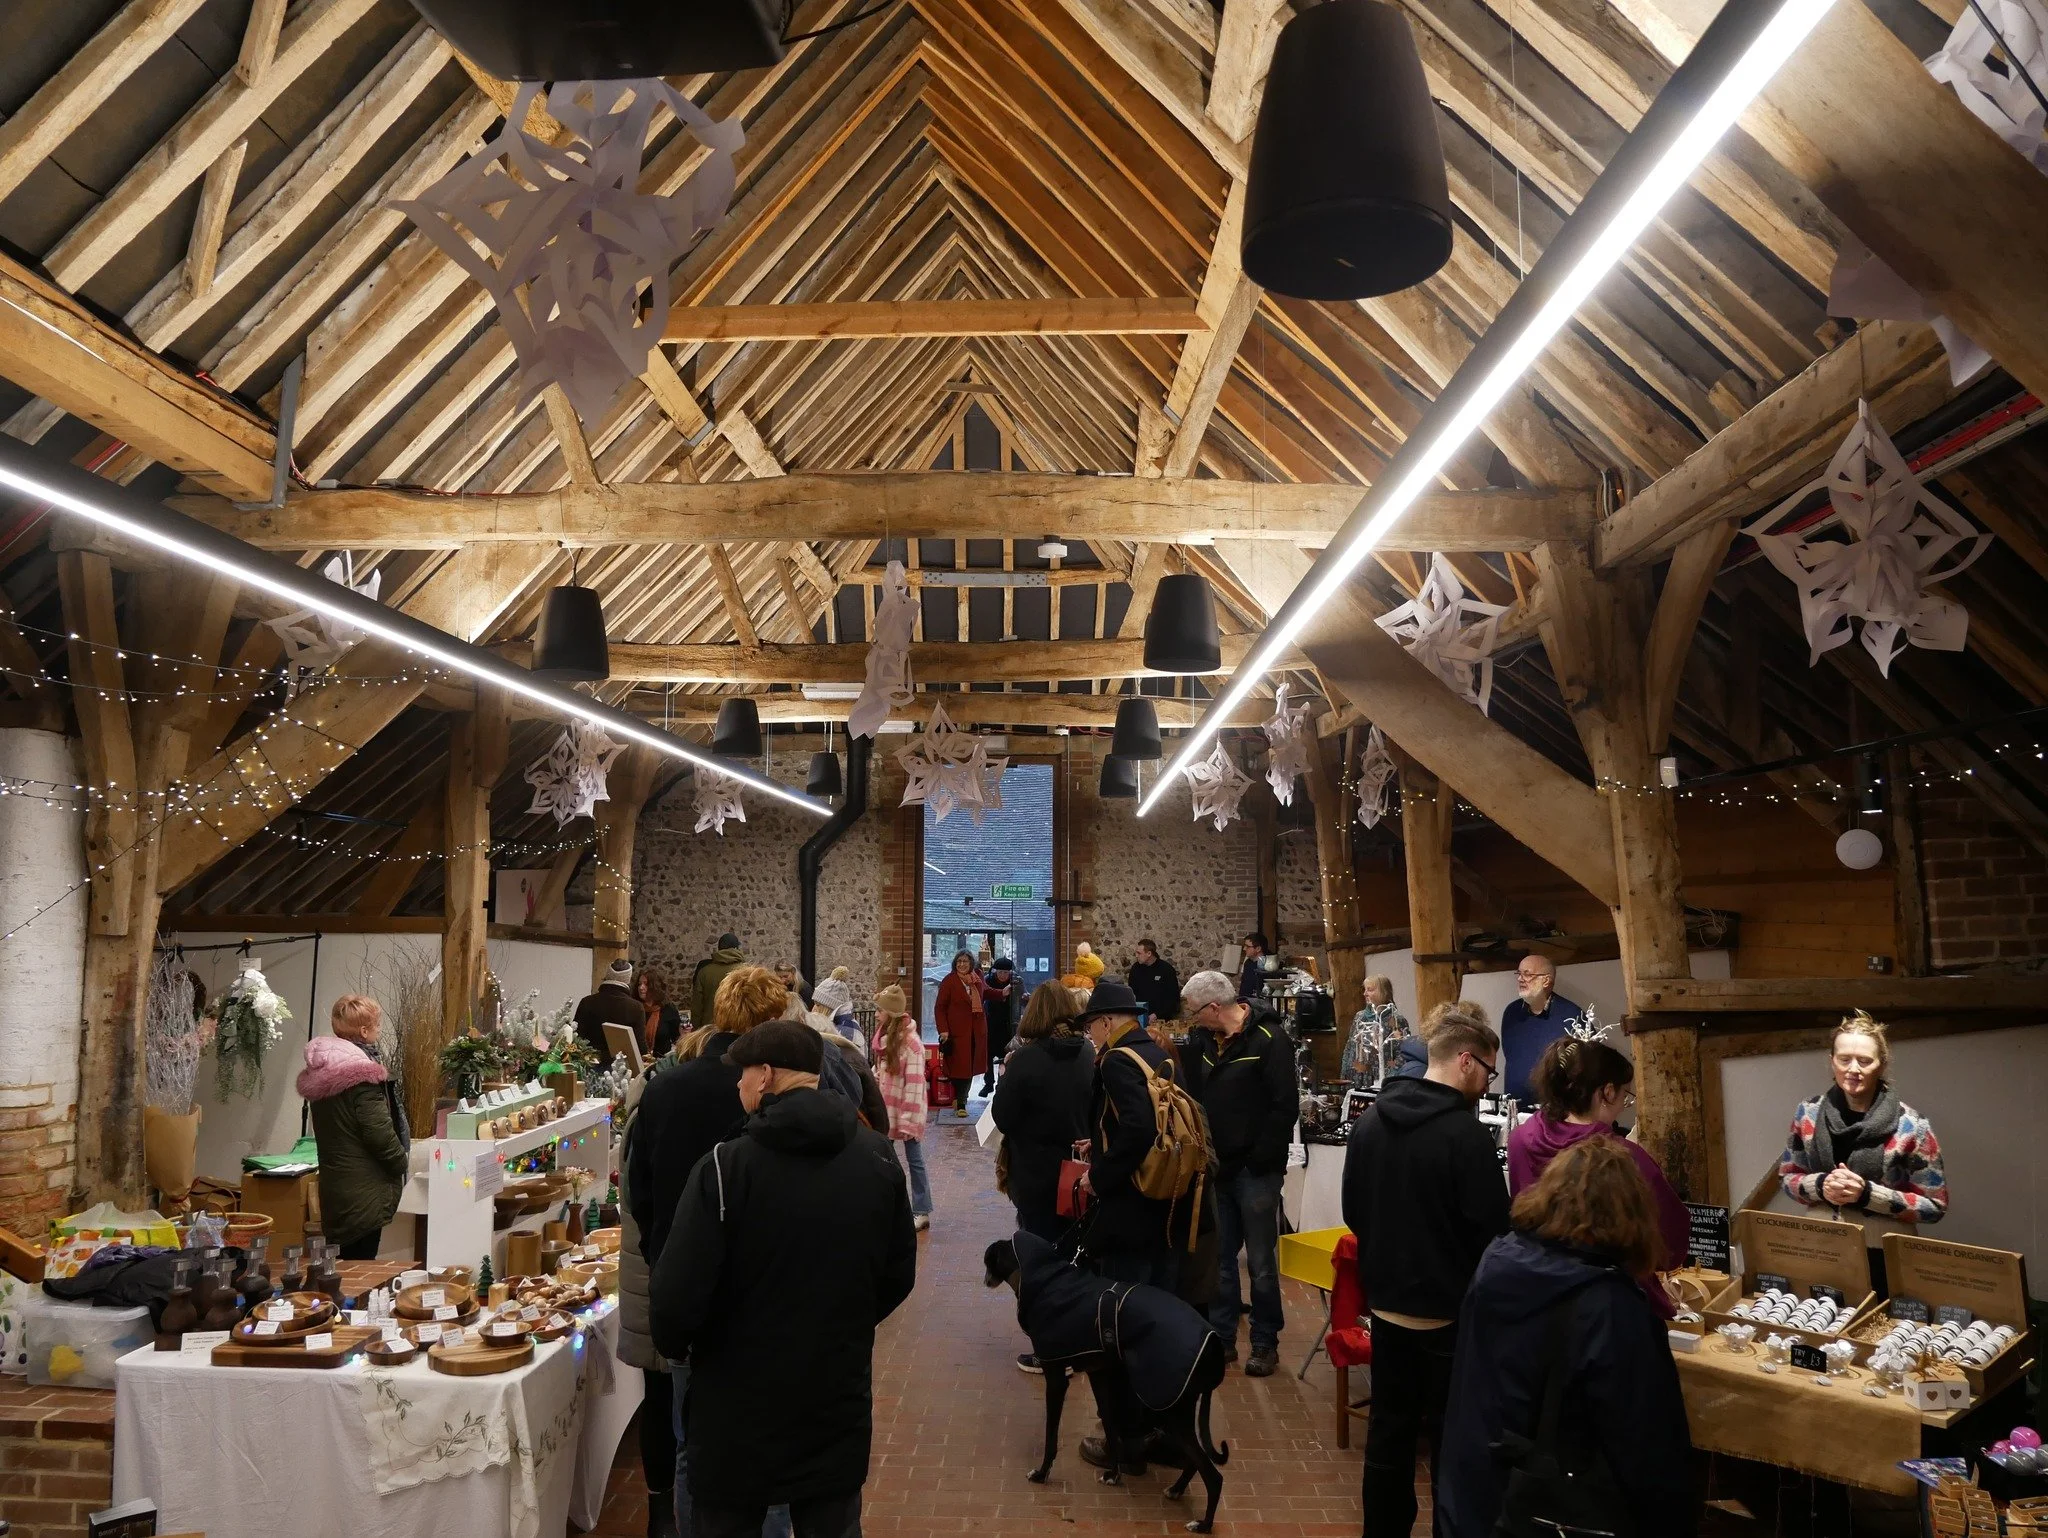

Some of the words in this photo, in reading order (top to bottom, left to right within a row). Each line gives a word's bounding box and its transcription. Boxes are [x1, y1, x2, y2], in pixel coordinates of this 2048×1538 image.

[1688, 1208, 1718, 1217] UCKMERE
[1690, 1216, 1719, 1224] RGANICS
[1756, 1218, 1800, 1230] CUCKMERE
[1802, 1224, 1848, 1236] ORGANICS
[1904, 1242, 1952, 1255] CUCKMERE
[1954, 1250, 2004, 1264] ORGANICS
[1793, 1348, 1805, 1357] TRY
[1810, 1353, 1820, 1366] £3
